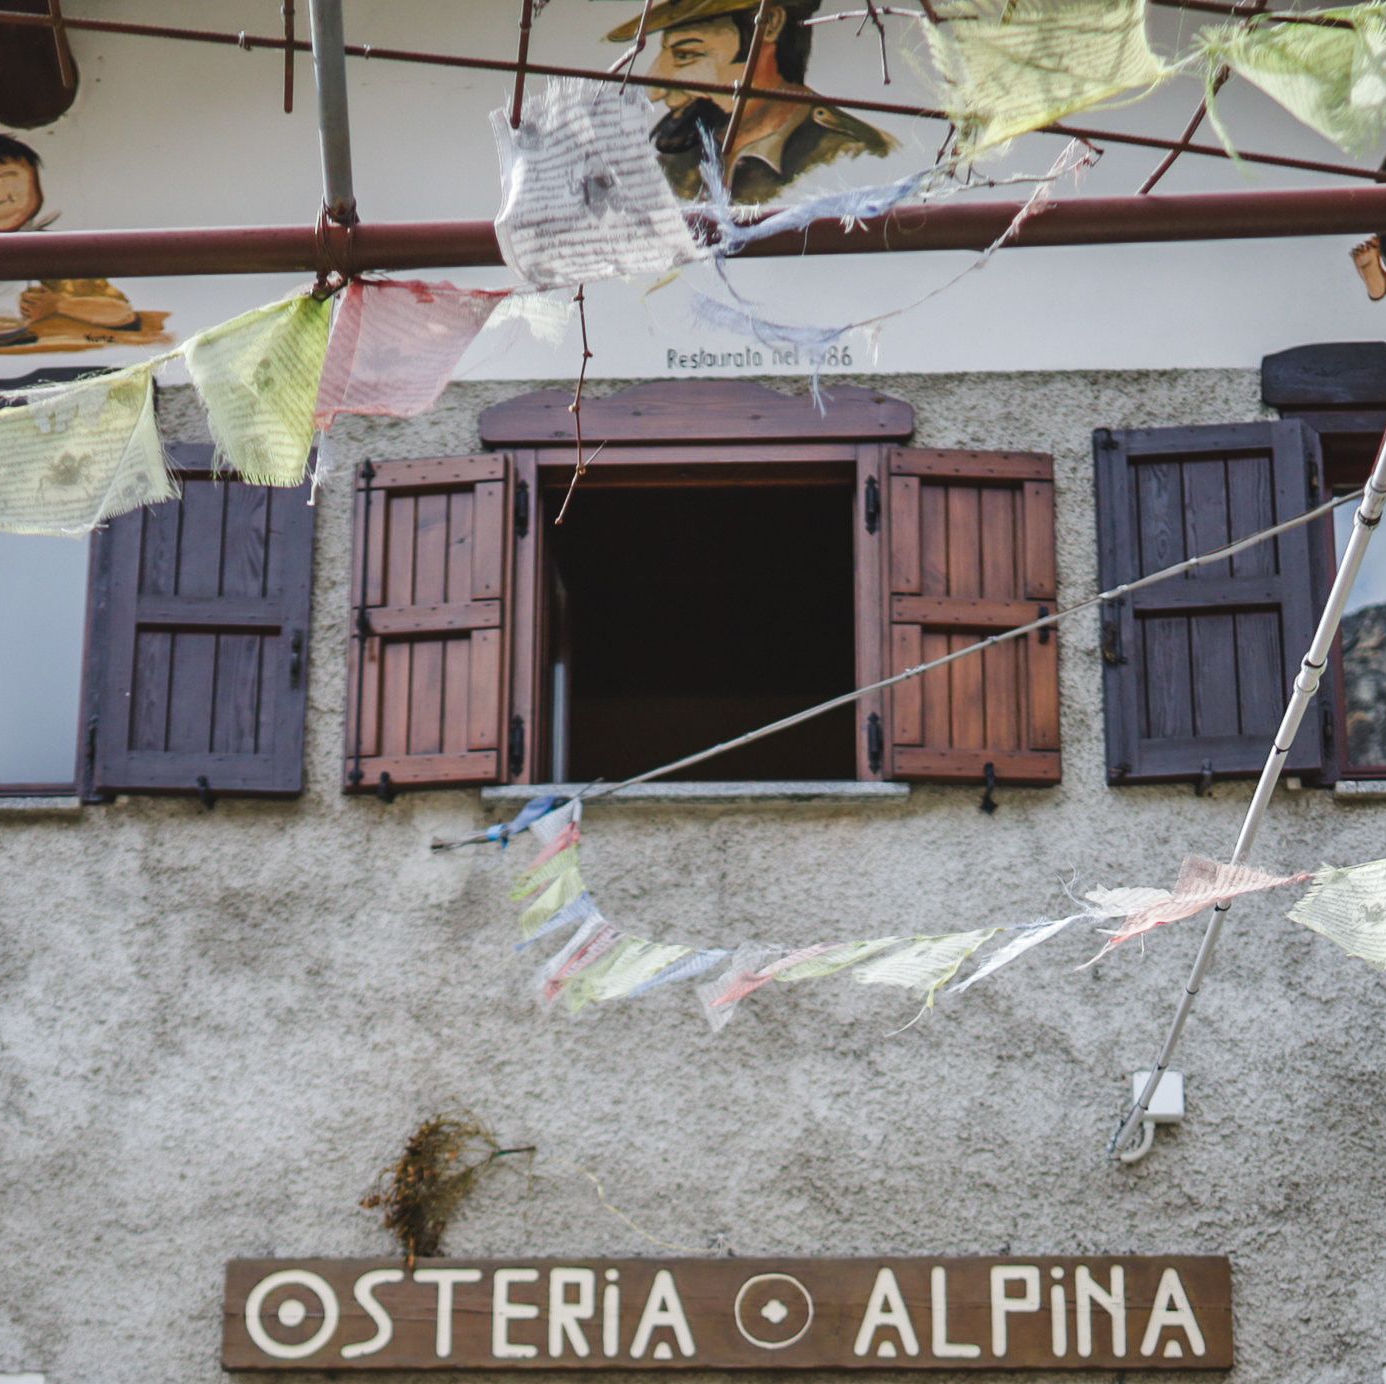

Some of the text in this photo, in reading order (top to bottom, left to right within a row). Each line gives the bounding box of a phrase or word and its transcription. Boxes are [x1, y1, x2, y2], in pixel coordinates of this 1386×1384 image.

[666, 346, 762, 369] Restaurato
[772, 343, 799, 366] nel
[244, 1264, 1208, 1360] OSTERIA ALPINA
